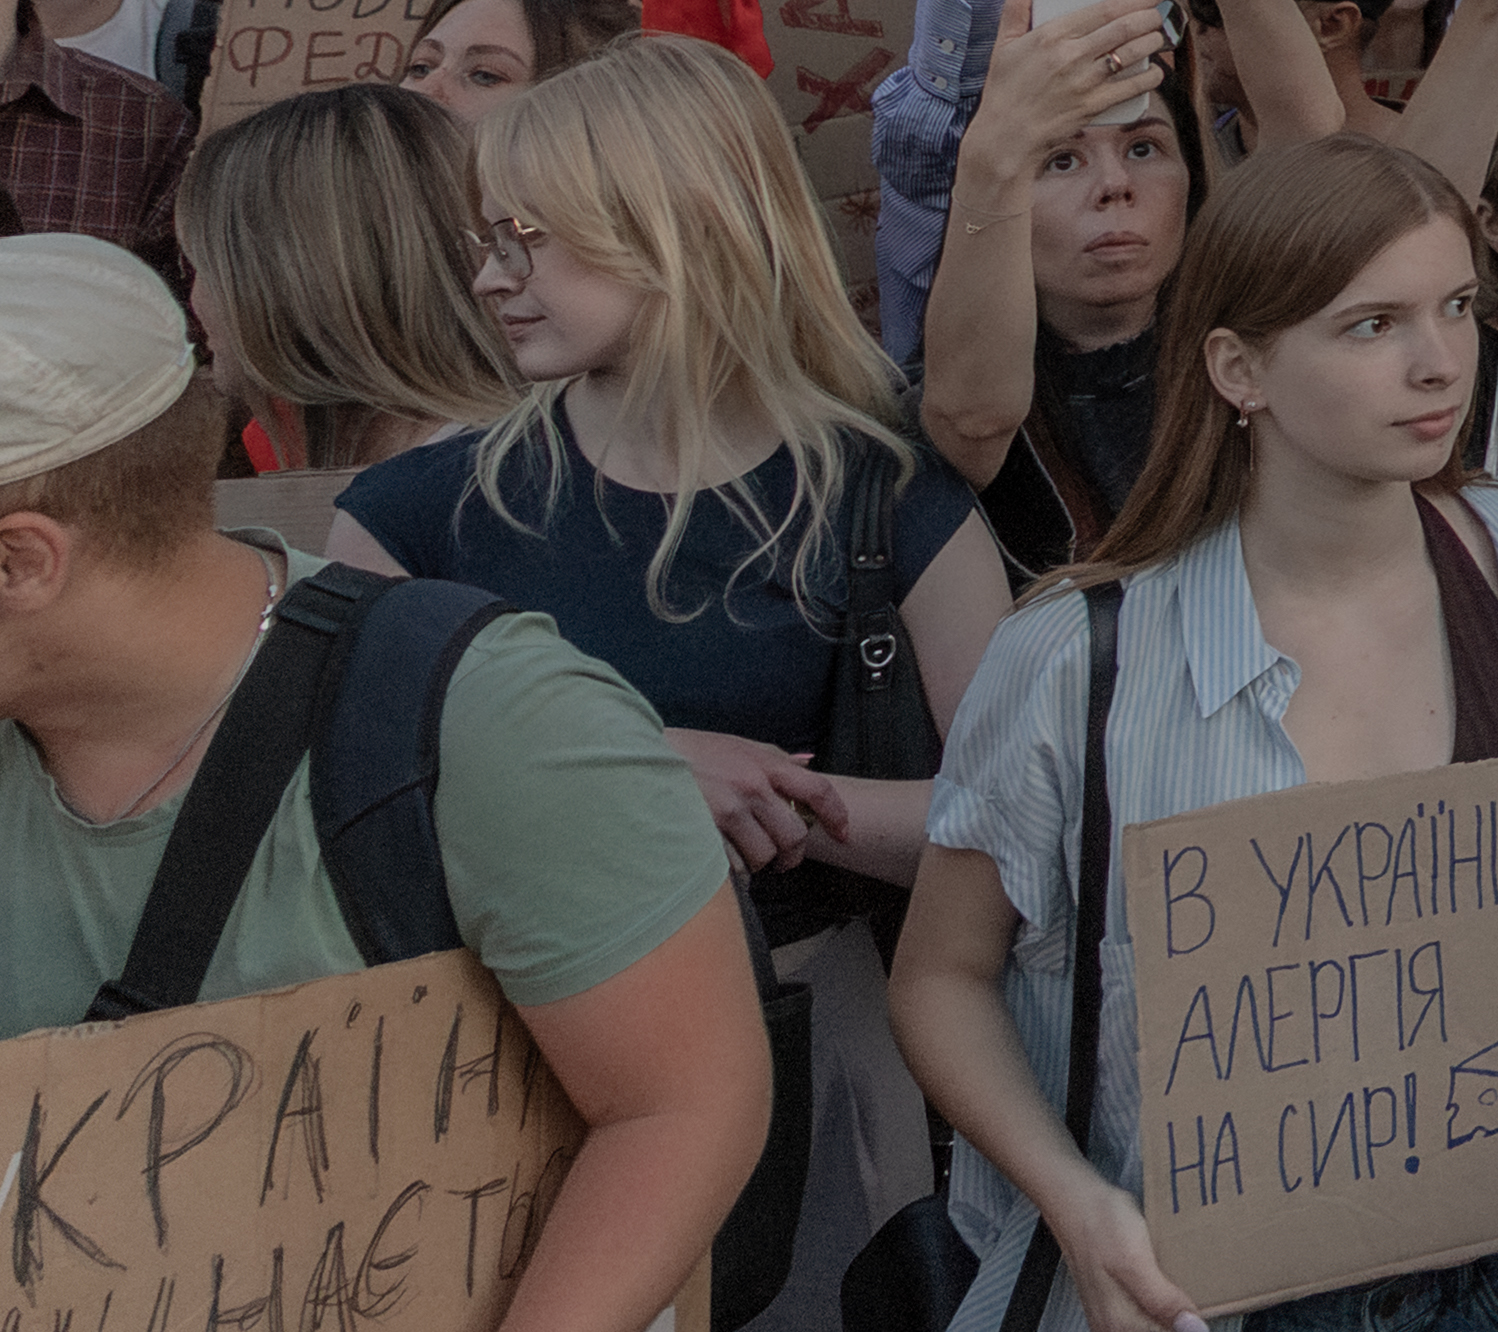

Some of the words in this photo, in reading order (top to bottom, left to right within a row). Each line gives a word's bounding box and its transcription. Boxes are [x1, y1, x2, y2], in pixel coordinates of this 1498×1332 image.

[1163, 844, 1217, 958] В
[1163, 939, 1450, 1097] АЛЕРГІЯ
[1166, 1111, 1245, 1215] НА
[1276, 1071, 1422, 1195] СИР!
